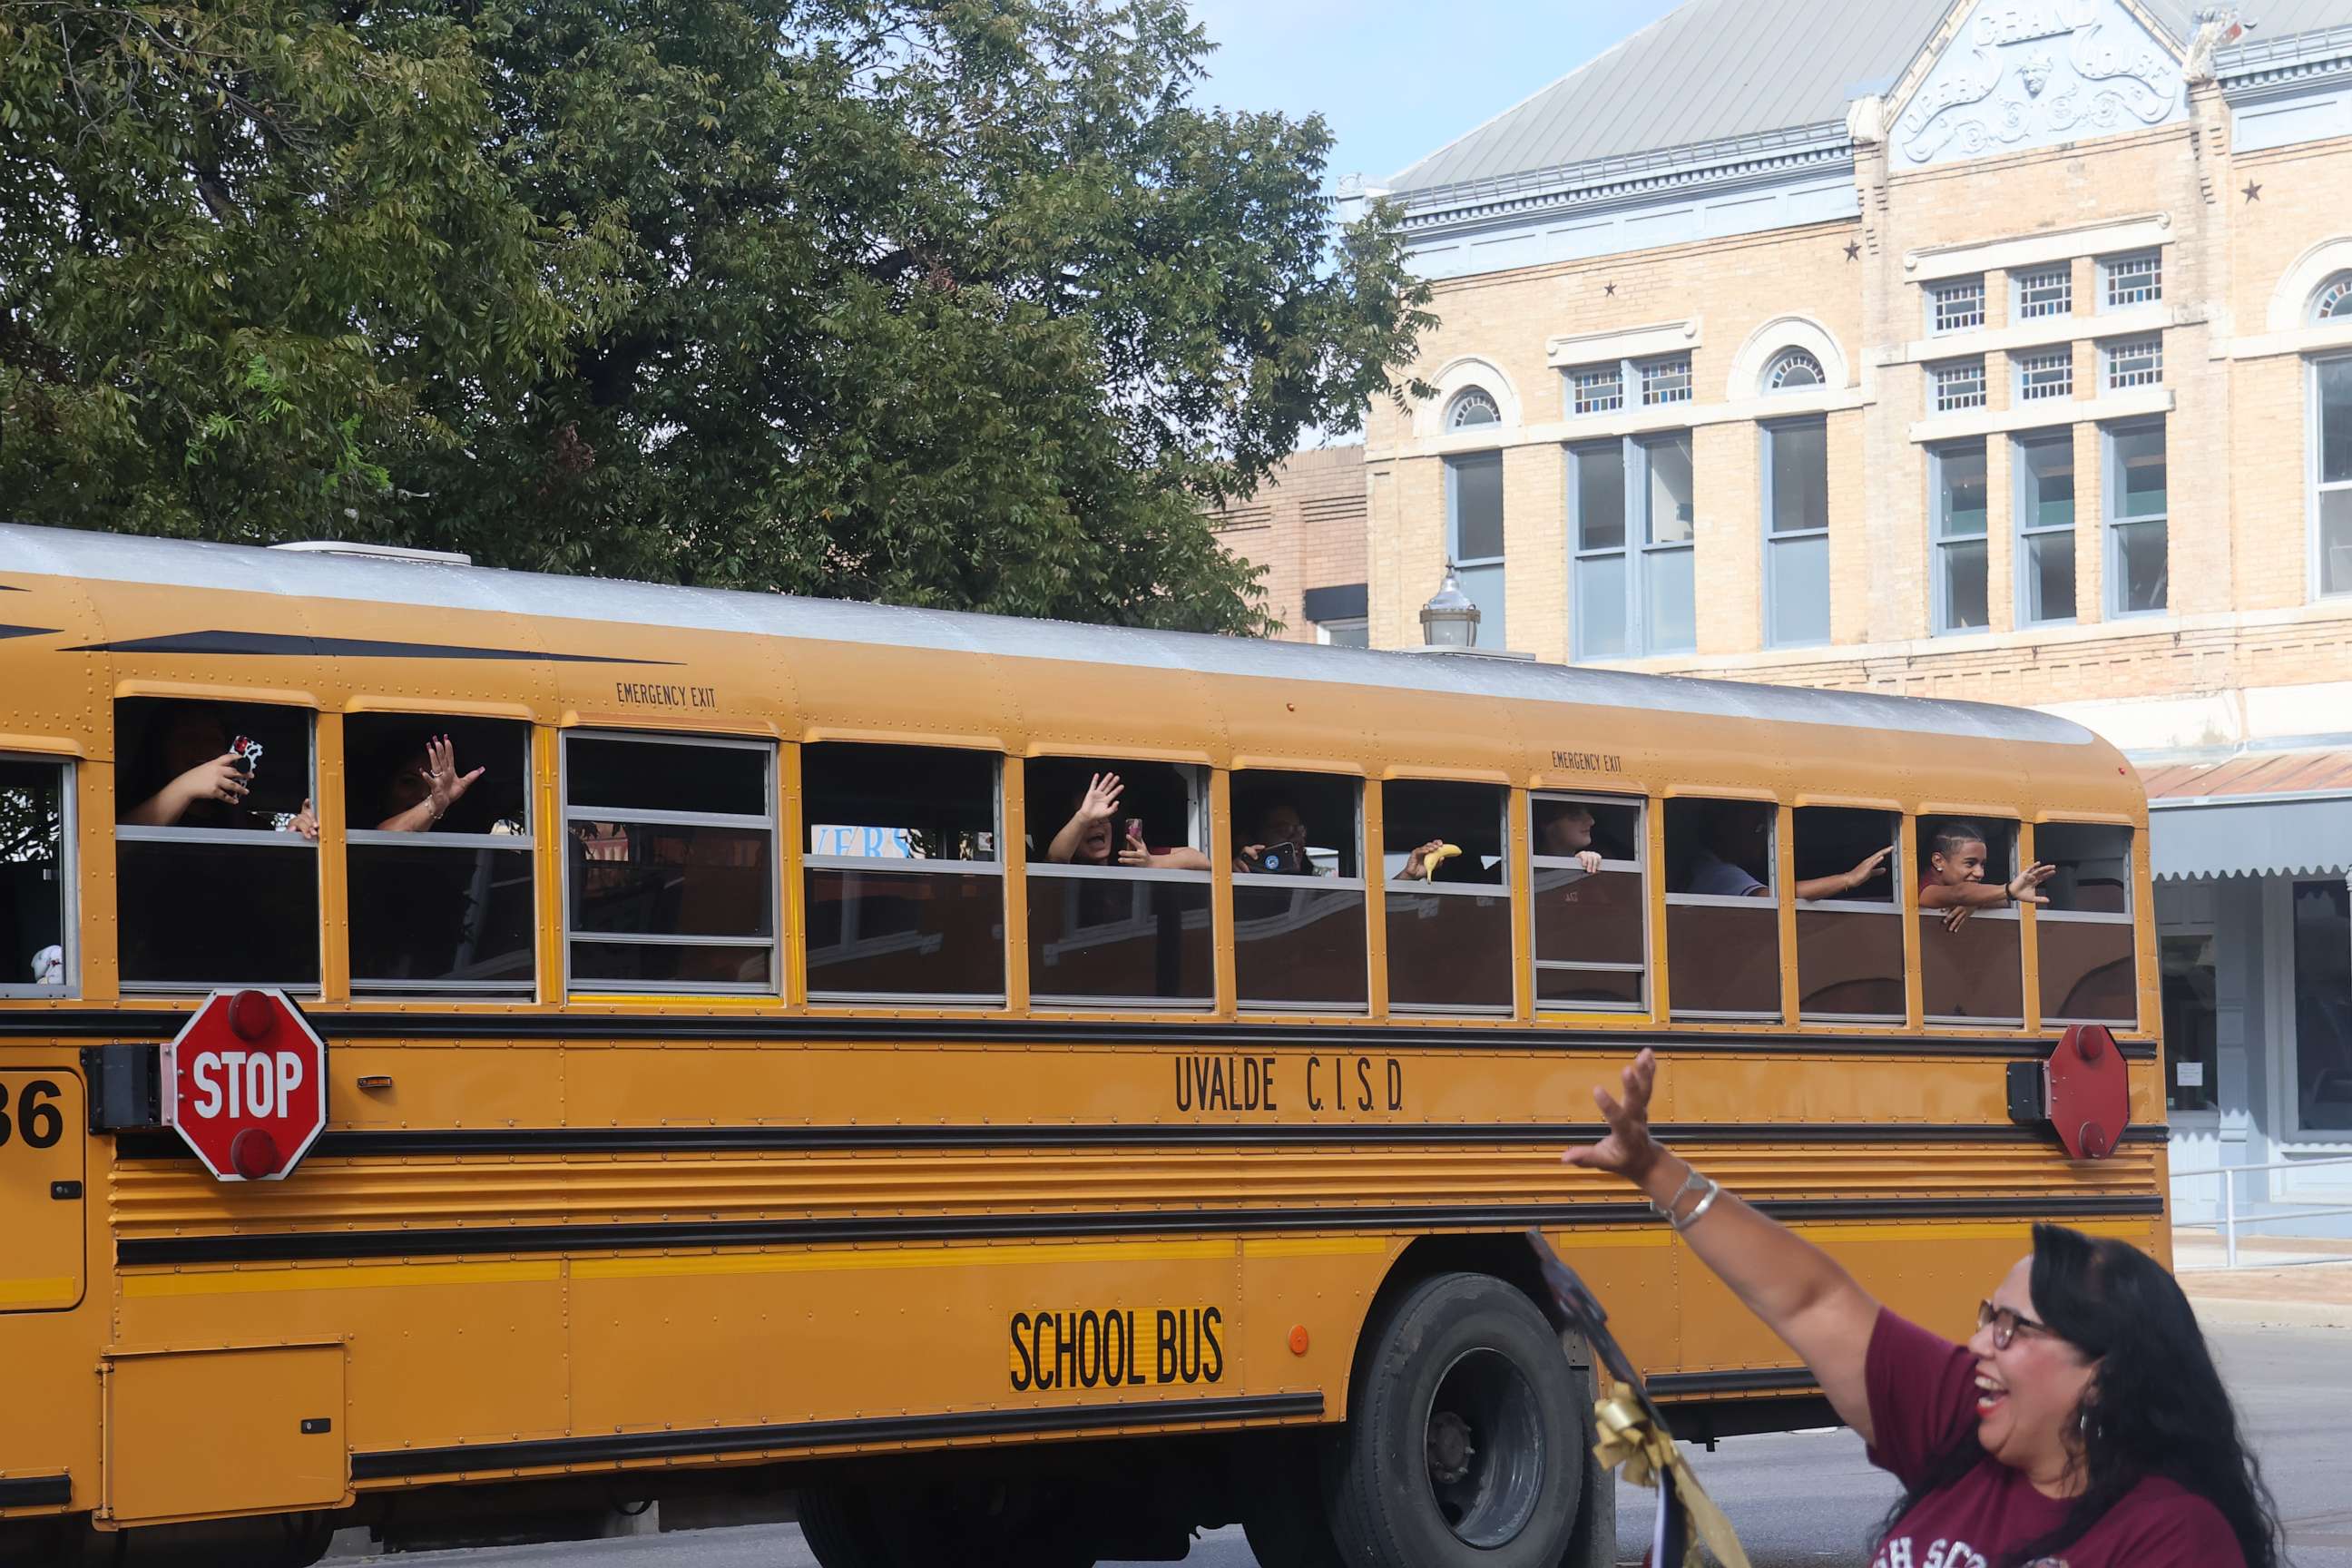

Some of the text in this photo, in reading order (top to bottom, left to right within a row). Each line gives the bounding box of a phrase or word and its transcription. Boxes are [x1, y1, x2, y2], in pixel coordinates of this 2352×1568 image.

[1975, 0, 2097, 46] GRAND
[1903, 45, 2171, 133] OPERA HOUSE
[616, 682, 716, 708] EMERGENCY EXIT
[1552, 750, 1622, 773] EMERGENCY EXIT
[193, 1052, 303, 1119] STOP
[1176, 1056, 1277, 1112] UVALDE
[1011, 1306, 1222, 1391] SCHOOL BUS
